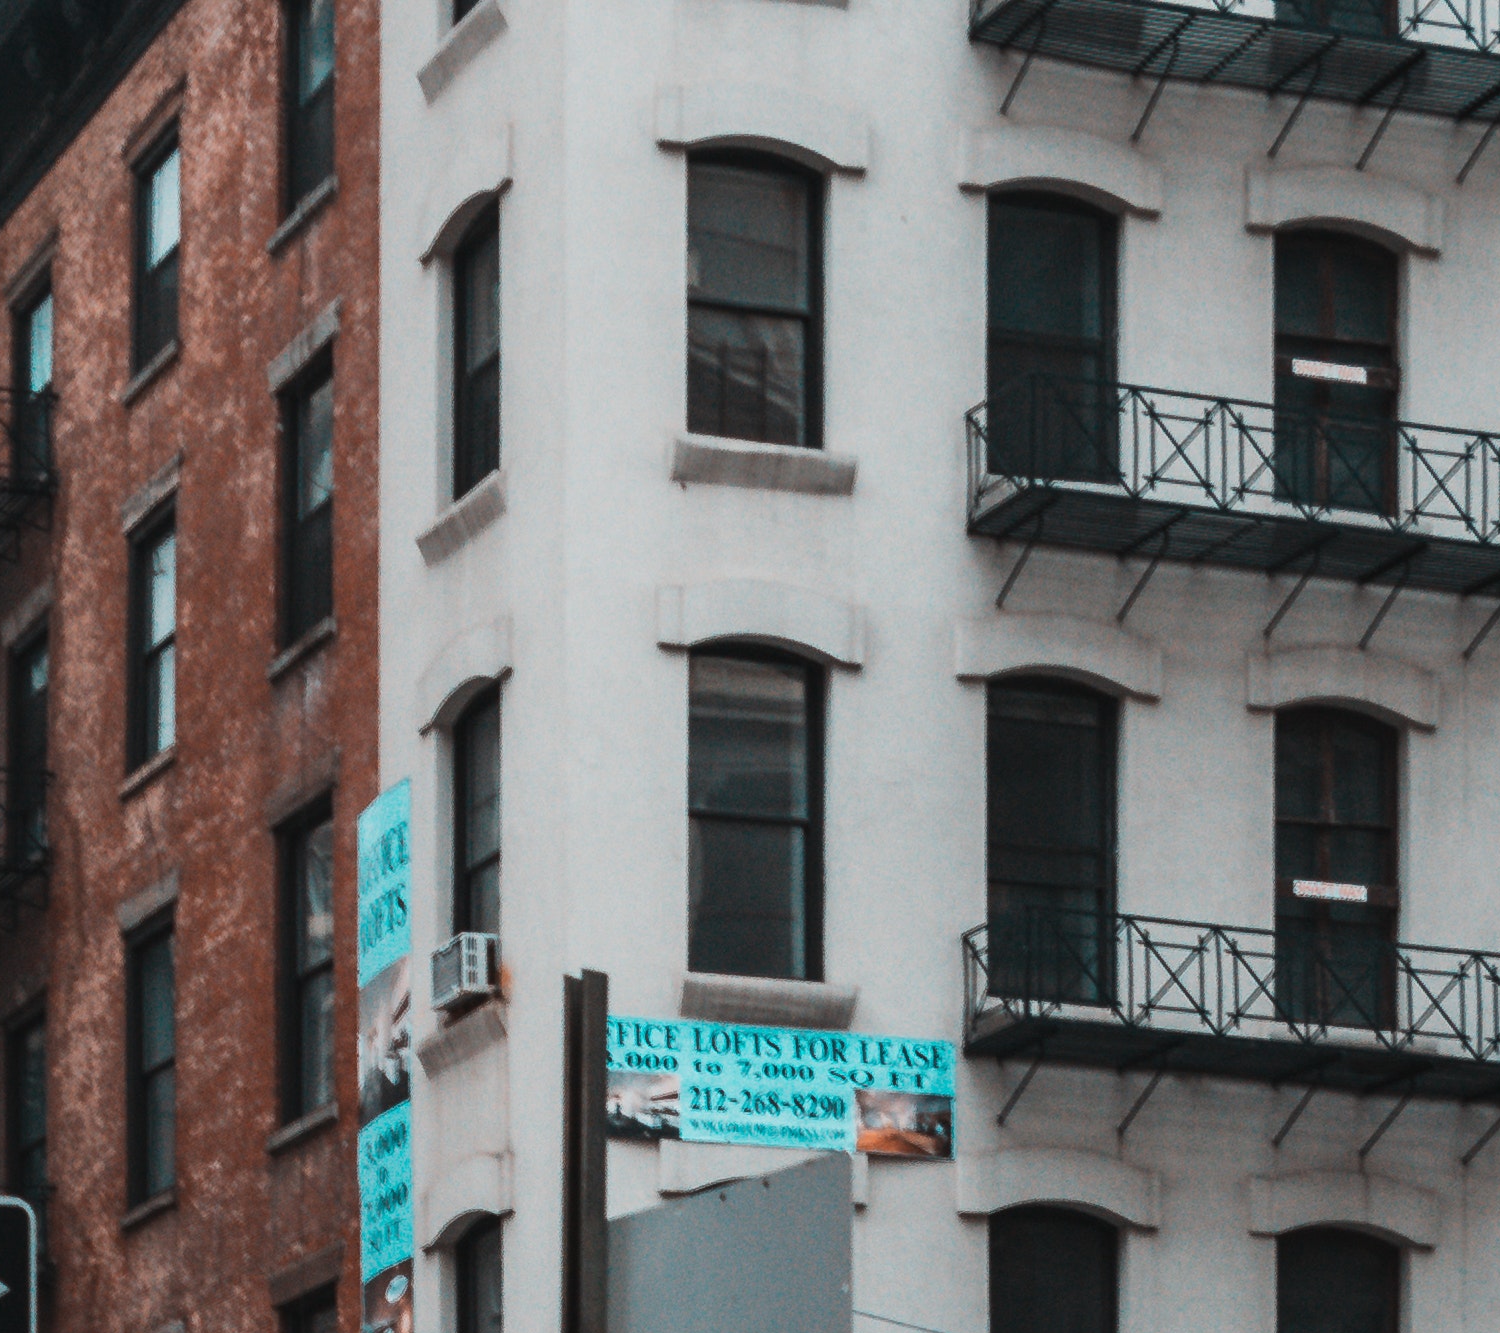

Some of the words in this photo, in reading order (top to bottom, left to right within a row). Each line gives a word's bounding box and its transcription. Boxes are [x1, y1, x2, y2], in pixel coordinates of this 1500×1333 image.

[606, 1020, 680, 1052] FICE
[690, 1026, 782, 1060] LOFTS
[791, 1034, 848, 1064] FOR
[859, 1037, 950, 1070] LEASE
[692, 1058, 723, 1075] to
[828, 1068, 875, 1089] SQ
[888, 1069, 928, 1090] FT
